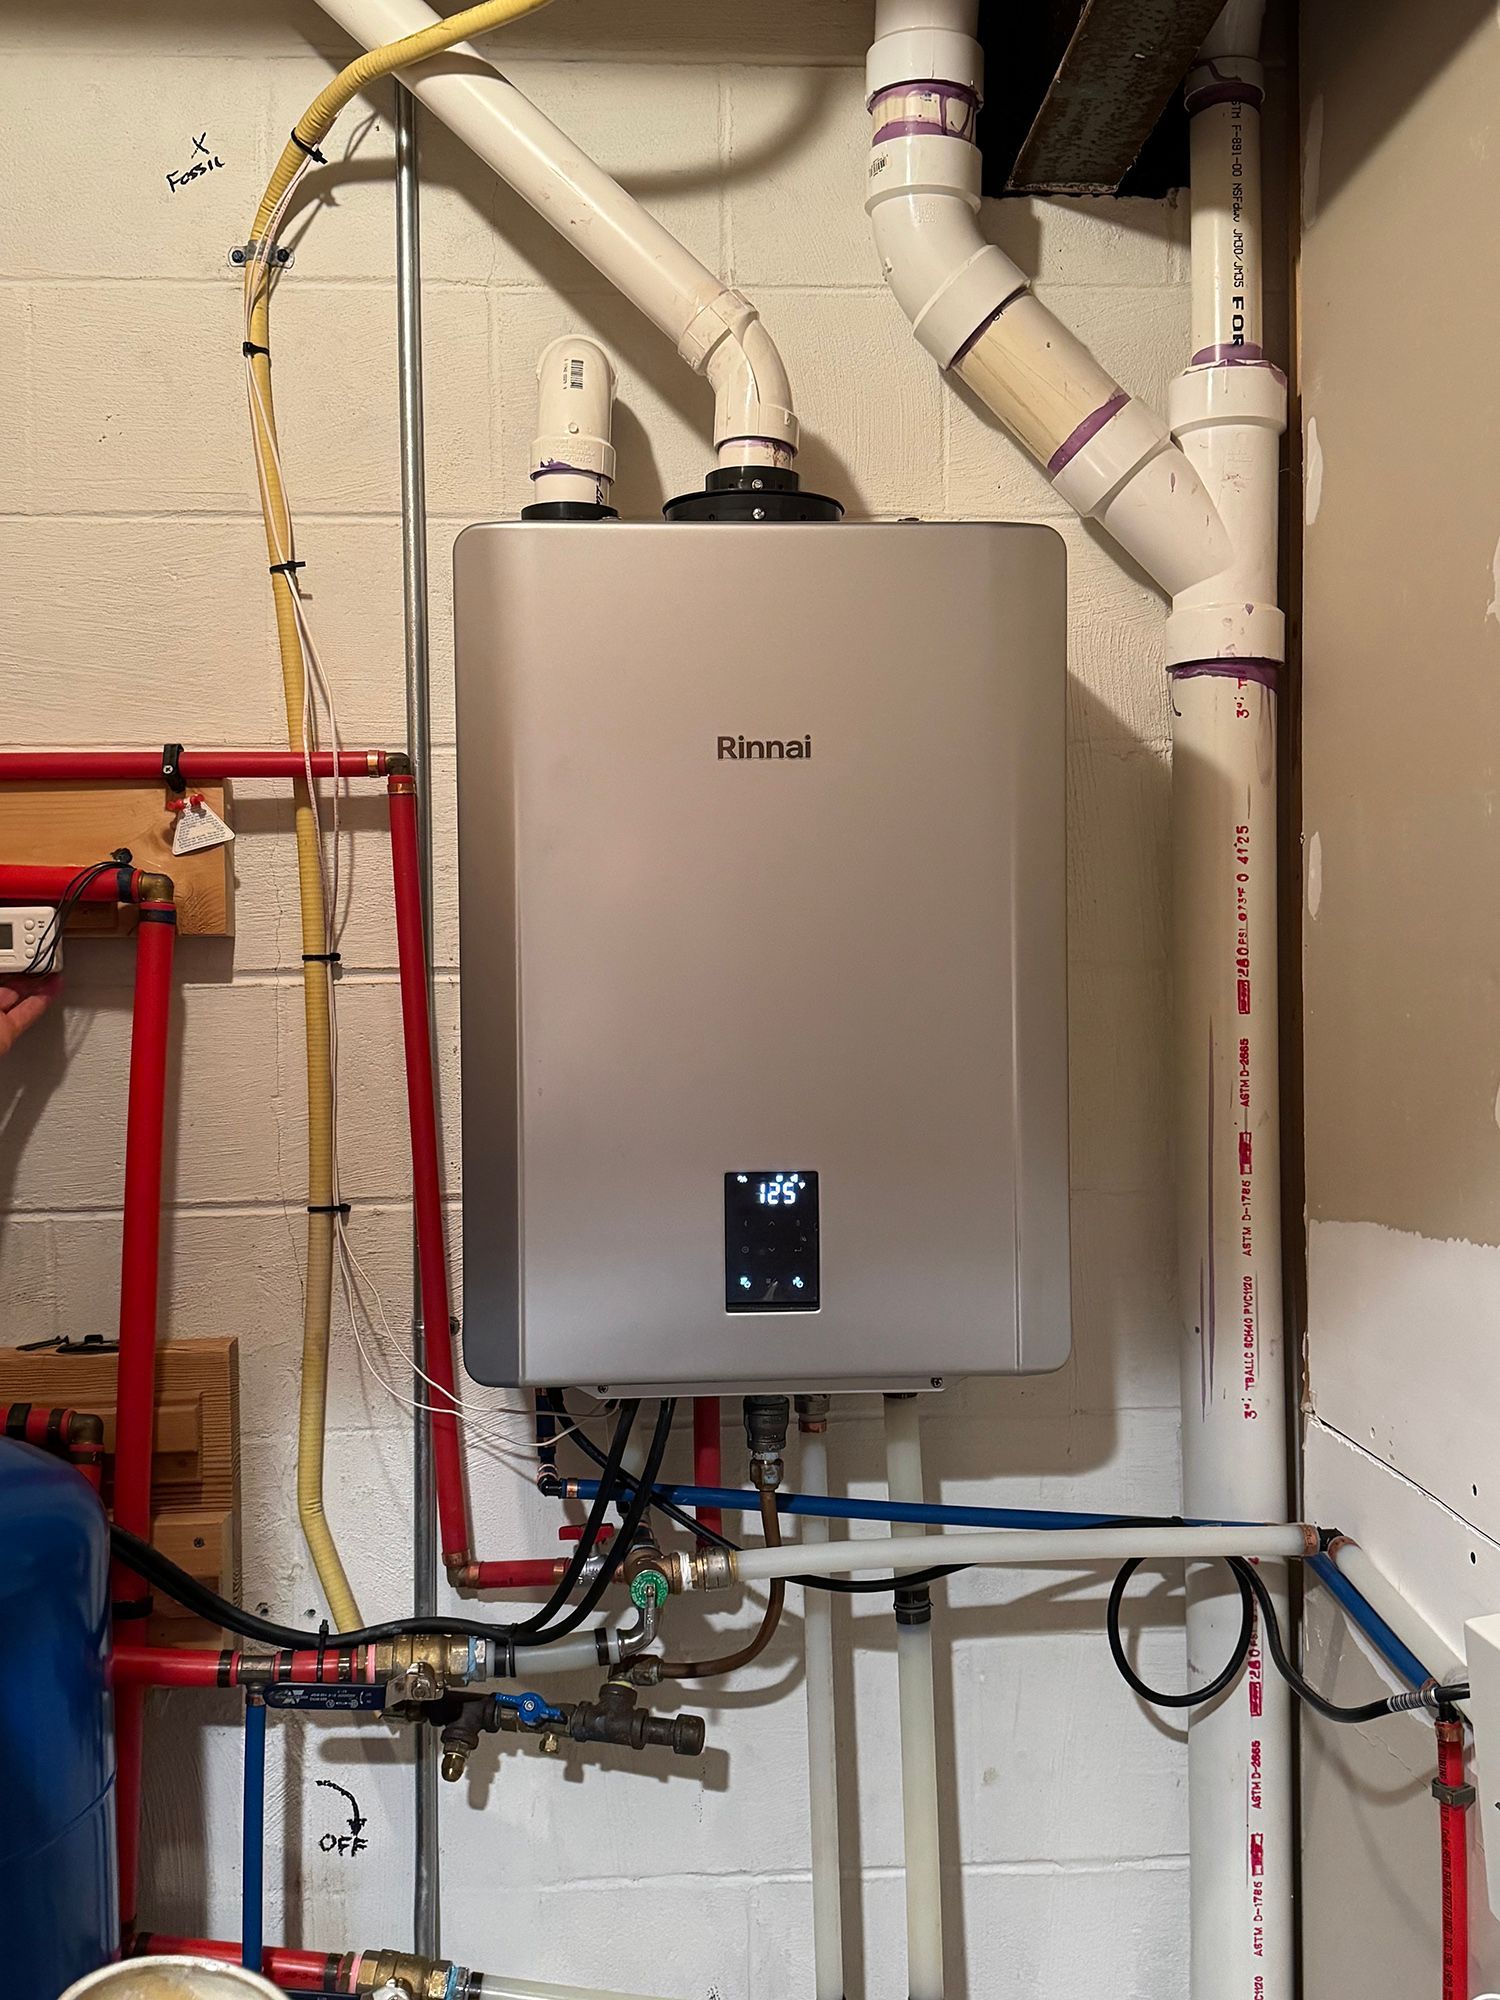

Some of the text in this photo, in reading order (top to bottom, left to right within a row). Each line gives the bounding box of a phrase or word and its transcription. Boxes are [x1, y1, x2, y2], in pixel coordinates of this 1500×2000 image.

[1231, 98, 1242, 119] STM
[1231, 125, 1242, 176] F-891-00
[1232, 183, 1242, 222] NSFdwv
[717, 734, 811, 760] Rinnai
[1236, 826, 1249, 865] 4125
[1240, 1079, 1250, 1107] ASTM
[759, 1182, 796, 1205] 125
[1242, 1180, 1252, 1221] D-1785
[1242, 1226, 1252, 1257] ASTM
[1251, 1782, 1262, 1809] ASTM
[318, 1832, 368, 1857] OFF
[1252, 1881, 1263, 1922] D-1785
[1253, 1926, 1263, 1957] ASTM
